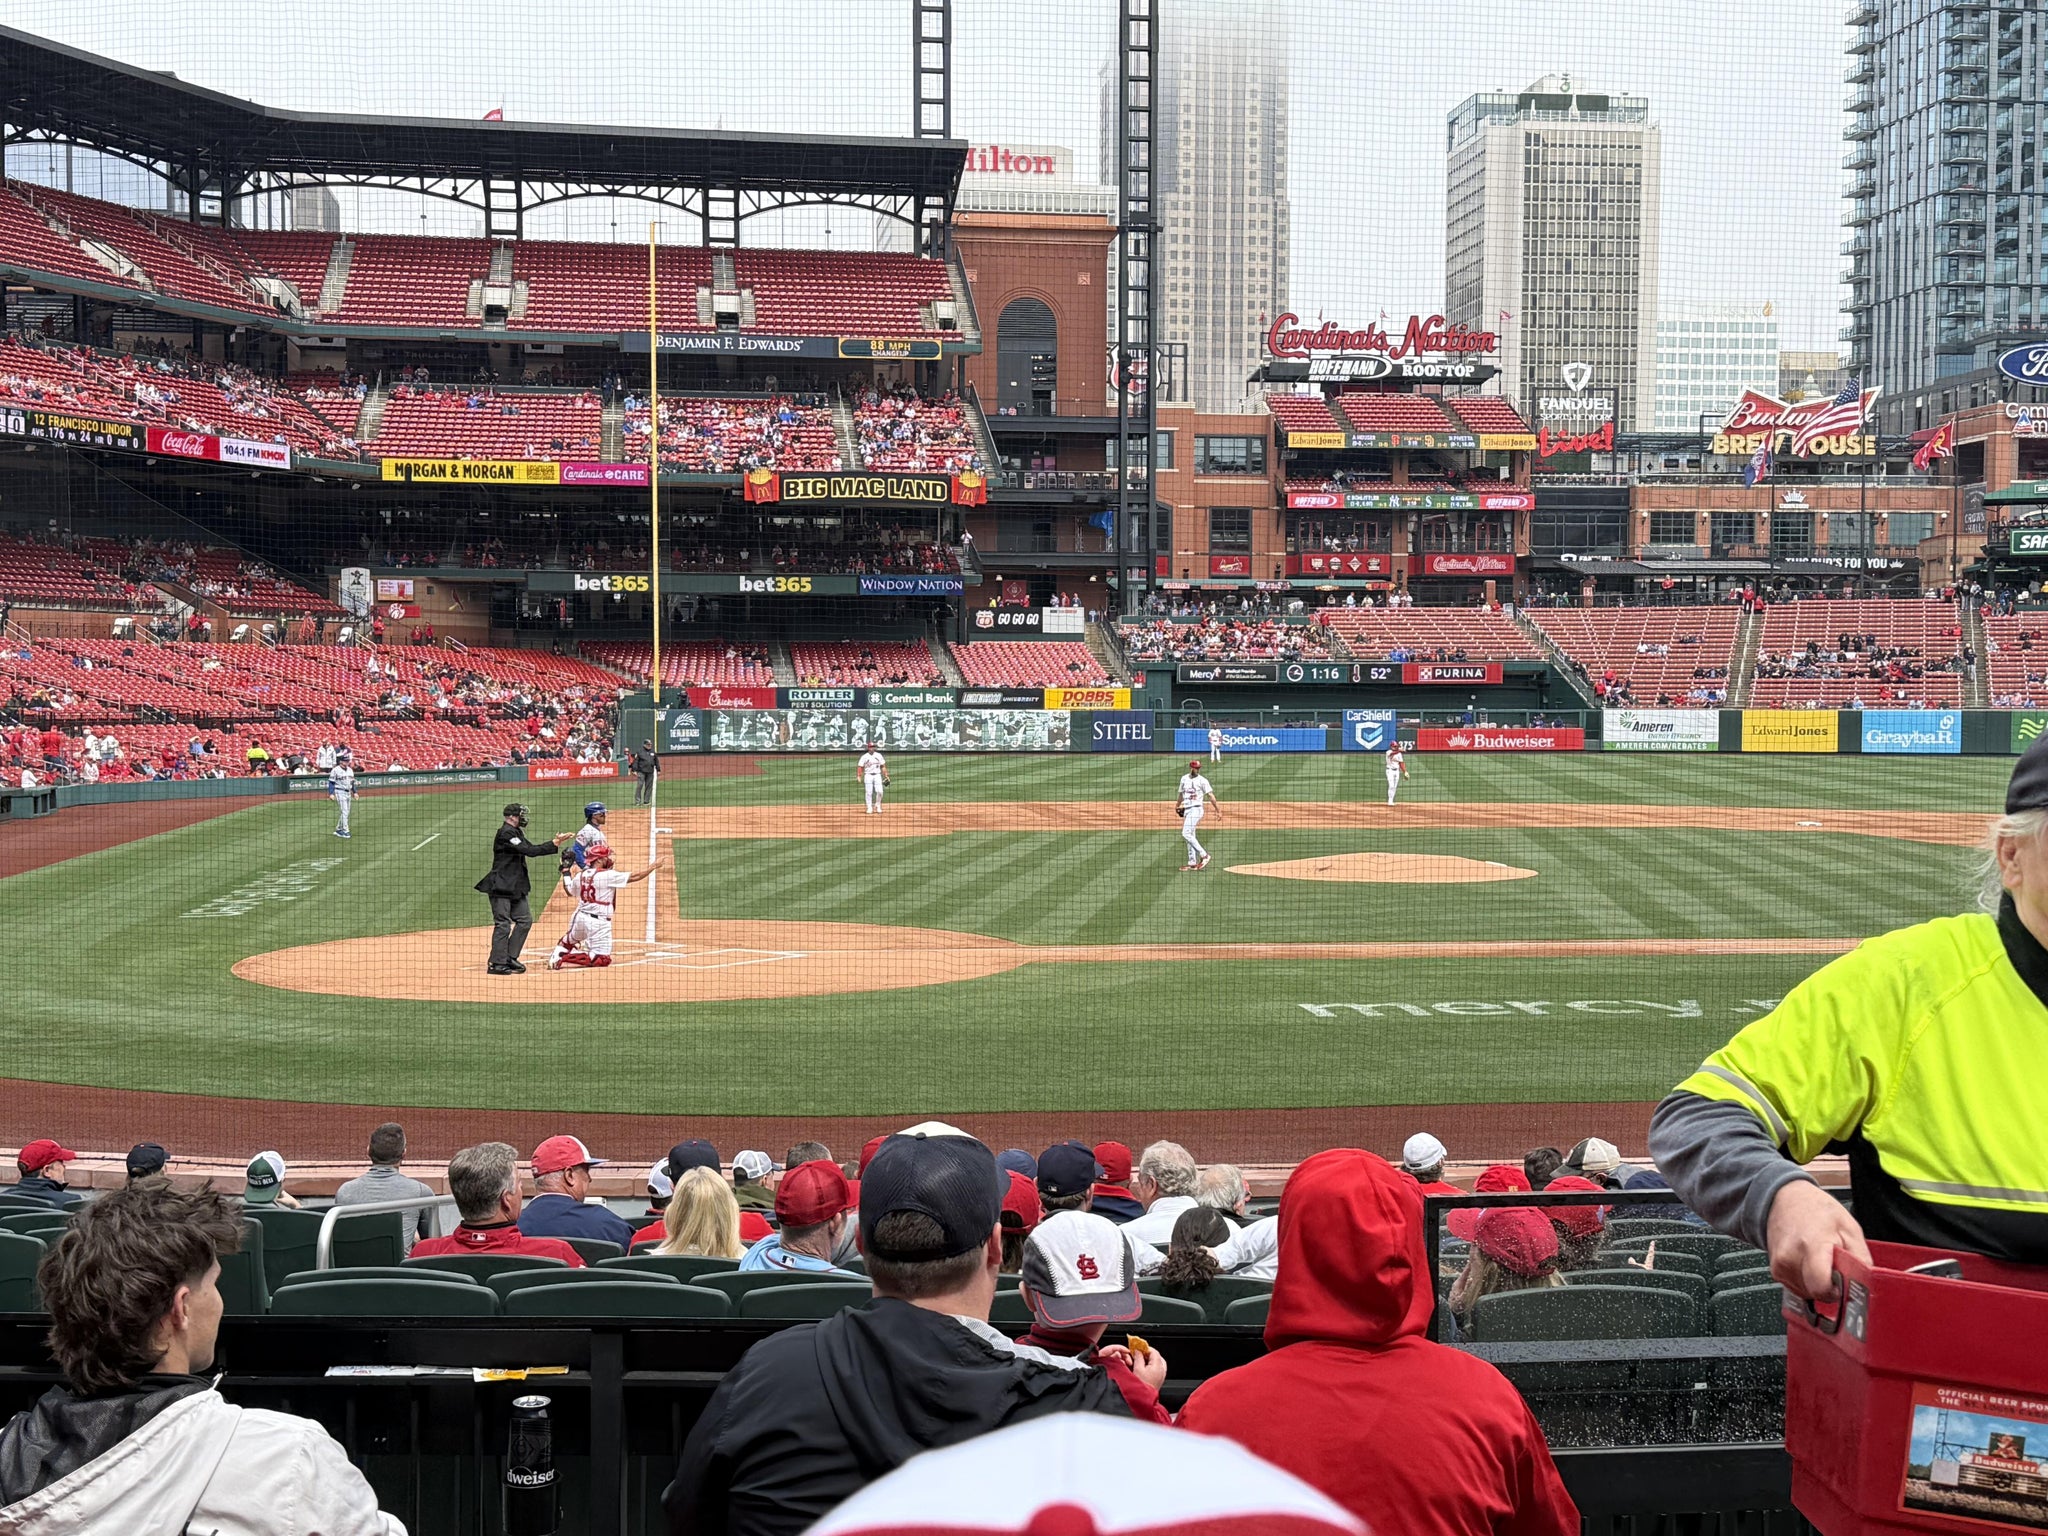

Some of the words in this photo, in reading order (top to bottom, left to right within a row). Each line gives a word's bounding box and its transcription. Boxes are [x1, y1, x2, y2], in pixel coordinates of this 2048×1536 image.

[1268, 312, 1389, 359] Cardinals
[1390, 314, 1498, 360] Nation
[870, 340, 884, 350] 88
[889, 342, 911, 351] MPH
[1309, 360, 1379, 376] HOFFMANN
[1402, 364, 1475, 377] ROOFTOP
[1539, 397, 1613, 410] FANDUEL
[34, 414, 45, 425] 12
[48, 415, 99, 432] FRANCISCO
[100, 422, 132, 437] LINDOR
[80, 431, 91, 443] 24
[1539, 422, 1614, 458] Live!
[224, 445, 245, 457] 104.1
[247, 449, 260, 459] FM
[261, 449, 286, 462] KMOX
[450, 464, 459, 478] &
[463, 464, 514, 479] MORGAN
[563, 465, 604, 482] Cardinals
[614, 469, 645, 481] CARE
[784, 478, 829, 499] BIG
[831, 477, 885, 499] MAC
[888, 478, 948, 502] LAND
[1867, 558, 1888, 569] YOU
[574, 574, 649, 592] bet365
[739, 575, 812, 593] bet365
[861, 578, 915, 591] WINDOW
[918, 579, 963, 591] NATION
[998, 613, 1010, 625] GO
[1012, 613, 1024, 625] GO
[1026, 613, 1039, 625] GO
[1190, 669, 1215, 680] Mercy
[1311, 668, 1339, 680] 1:16
[1371, 667, 1391, 680] 52°
[1434, 668, 1483, 679] PURINA
[791, 690, 852, 700] ROTTLER
[886, 692, 923, 704] Central
[926, 692, 955, 704] Bank
[1063, 690, 1115, 702] DOBBS
[791, 701, 809, 709] PEST
[811, 701, 852, 709] SOLUTIONS
[1347, 710, 1392, 722] CarShield
[1093, 721, 1152, 740] STIFEL
[1632, 720, 1674, 733] Ameren
[1222, 734, 1275, 748] Spectrum
[1474, 733, 1555, 748] Budweiser
[1615, 742, 1708, 750] AMEREN.COM/REBATES
[1298, 999, 1703, 1019] mercy
[1937, 1388, 1985, 1403] OFFICIAL
[1989, 1396, 2018, 1408] BEER
[1940, 1396, 1961, 1406] THE
[1974, 1456, 2036, 1474] Budweiser
